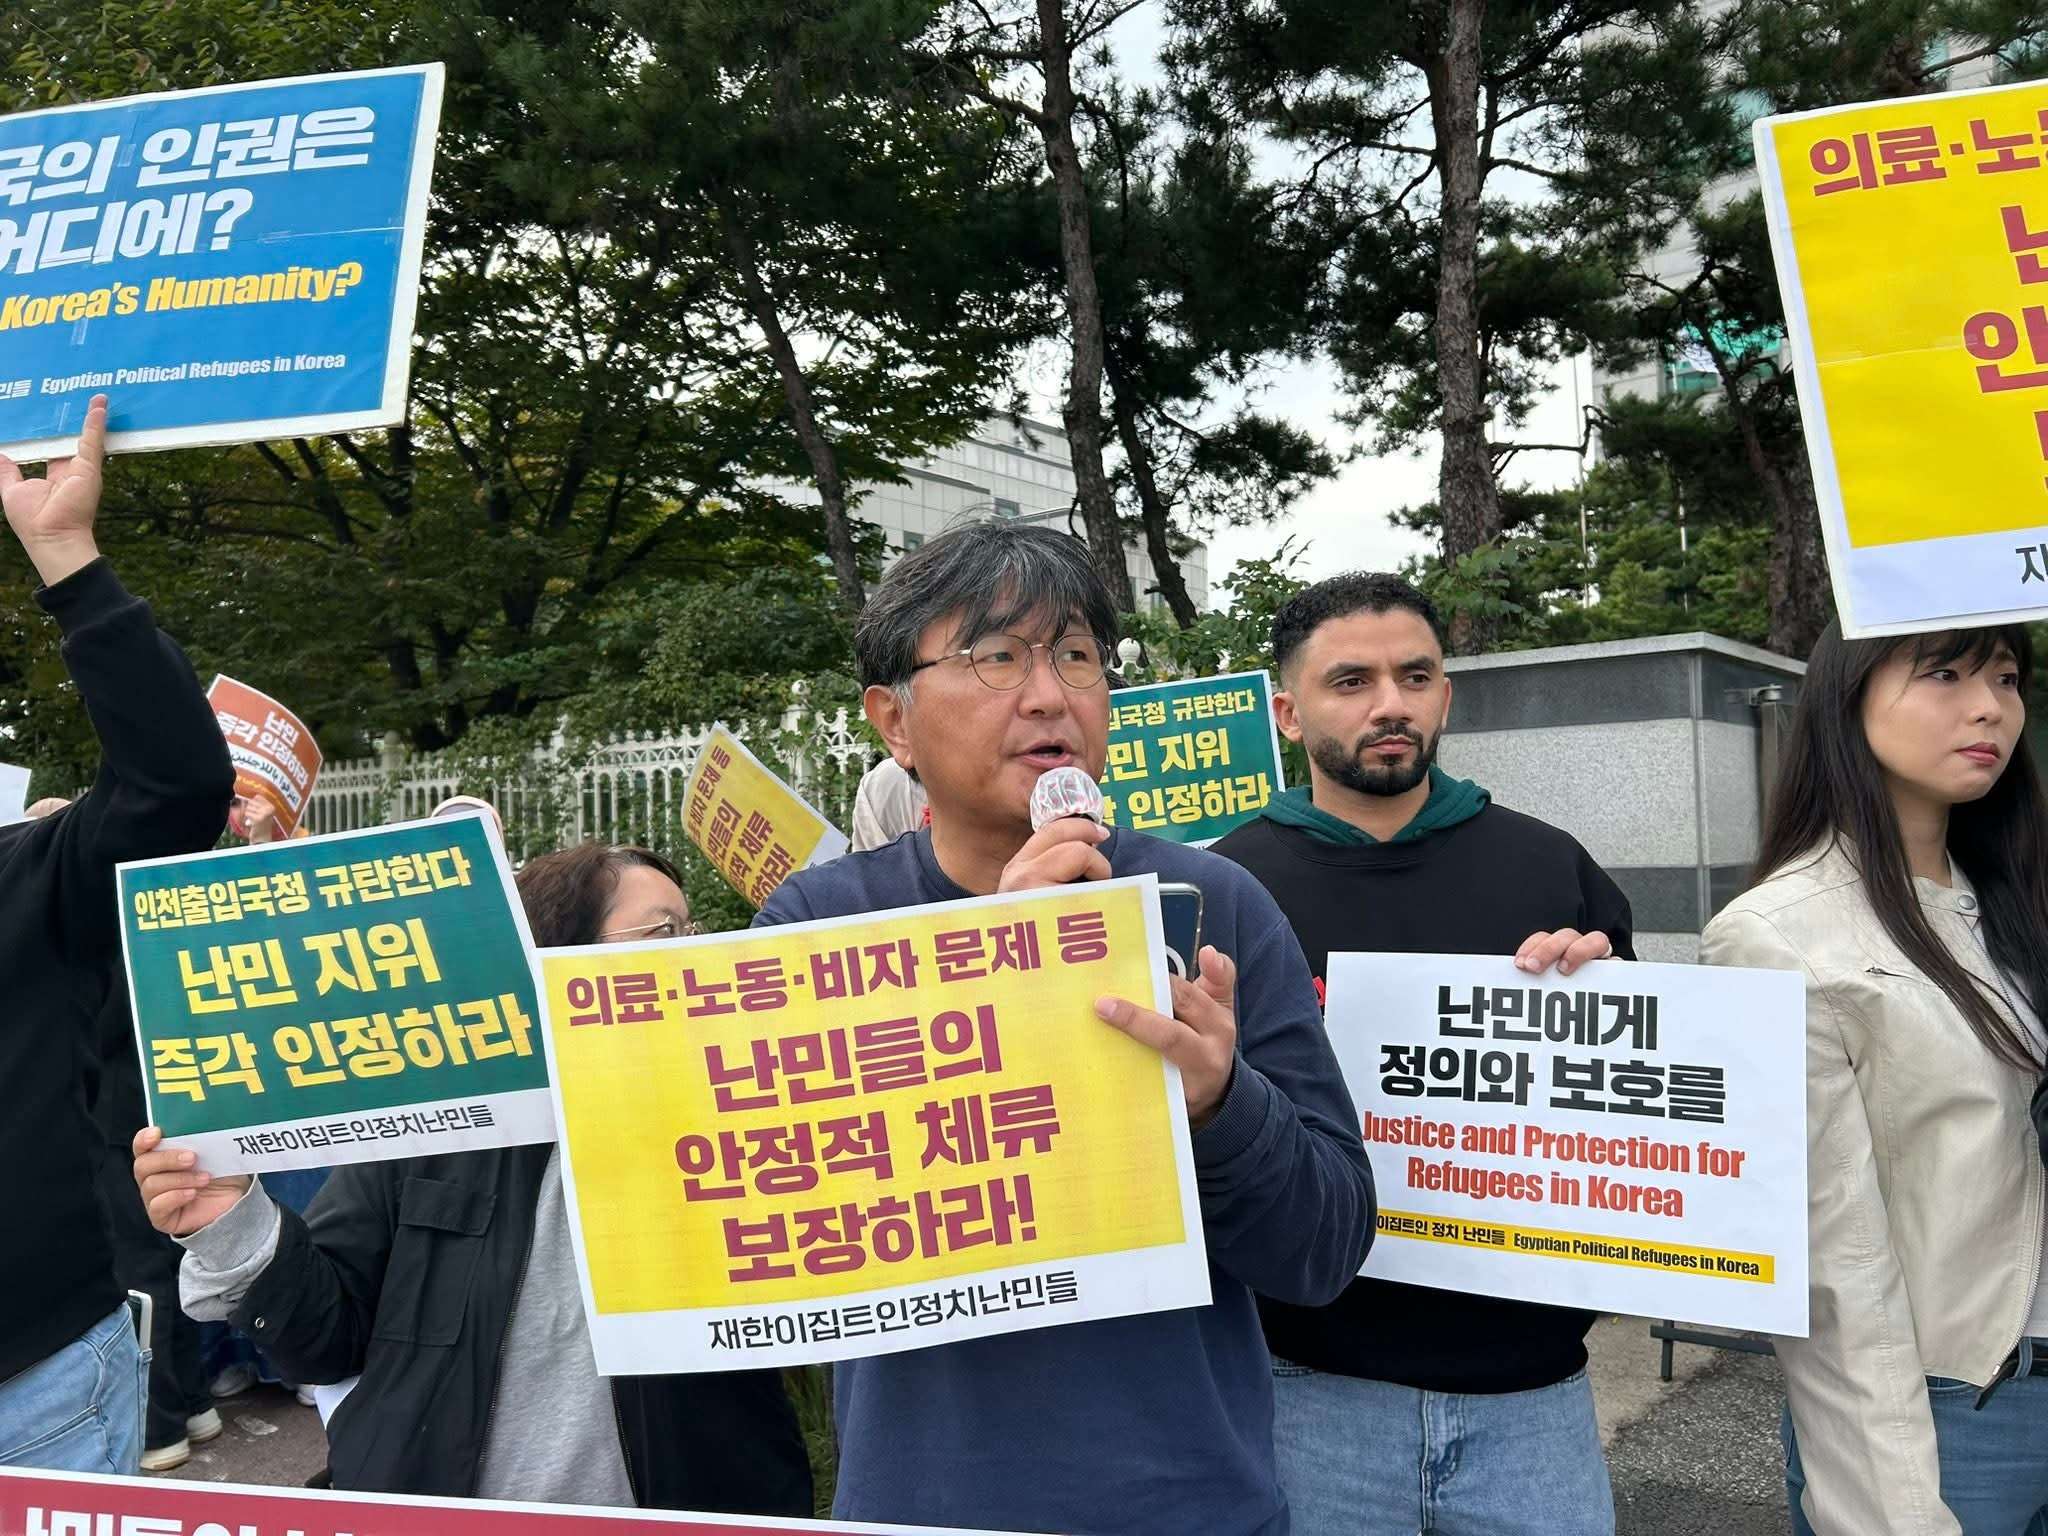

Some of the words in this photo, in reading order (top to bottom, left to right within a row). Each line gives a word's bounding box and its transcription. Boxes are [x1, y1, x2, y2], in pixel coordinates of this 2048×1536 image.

[136, 106, 375, 188] 인권은
[1809, 107, 2048, 196] 의료·노
[0, 188, 253, 275] 어디에?
[0, 282, 140, 331] Korea's
[144, 262, 363, 312] Humanity?
[40, 371, 113, 395] Egyptian
[115, 363, 187, 385] Political
[189, 358, 270, 379] Refugees
[273, 356, 291, 371] in
[293, 353, 346, 370] Korea
[264, 711, 299, 748] 난민
[1172, 689, 1256, 722] 규탄한다
[697, 763, 722, 800] 문제
[711, 745, 731, 769] 등
[1099, 739, 1148, 784] 민
[1157, 728, 1231, 773] 지위
[738, 809, 774, 861] 체류
[1127, 772, 1271, 830] 인정하라
[134, 871, 311, 931] 인천출입국청
[314, 846, 472, 907] 규탄한다
[176, 939, 299, 1016] 난민
[302, 917, 443, 997] 지위
[566, 937, 919, 1028] 의료·노동·비자
[935, 921, 1041, 983] 문제
[1056, 911, 1109, 963] 등
[151, 1032, 265, 1102] 즉각
[273, 993, 533, 1089] 인정하라
[1437, 985, 1659, 1051] 난민에게
[704, 1003, 1003, 1113] 난민들의
[1378, 1044, 1535, 1107] 정의와
[1549, 1055, 1727, 1124] 보호를
[232, 1104, 496, 1156] 재한이집트인정치난민들
[673, 1110, 895, 1202] 안정적
[913, 1084, 1061, 1171] 체류
[1362, 1111, 1455, 1149] Justice
[1461, 1124, 1516, 1155] and
[1524, 1125, 1691, 1172] Protection
[1697, 1141, 1745, 1179] for
[1407, 1157, 1543, 1202] Refugees
[1550, 1172, 1580, 1206] in
[1588, 1175, 1684, 1218] Korea
[721, 1173, 1037, 1283] 보장하라!
[1377, 1215, 1428, 1235] 이집트인
[1432, 1222, 1459, 1239] 정치
[1463, 1226, 1505, 1245] 난민들
[1514, 1233, 1569, 1253] Egyptian
[1573, 1241, 1628, 1260] Political
[1632, 1247, 1697, 1268] Refugees
[1700, 1255, 1714, 1271] in
[1717, 1256, 1760, 1277] Korea
[706, 1269, 1079, 1352] 재한이집트인정치난민들
